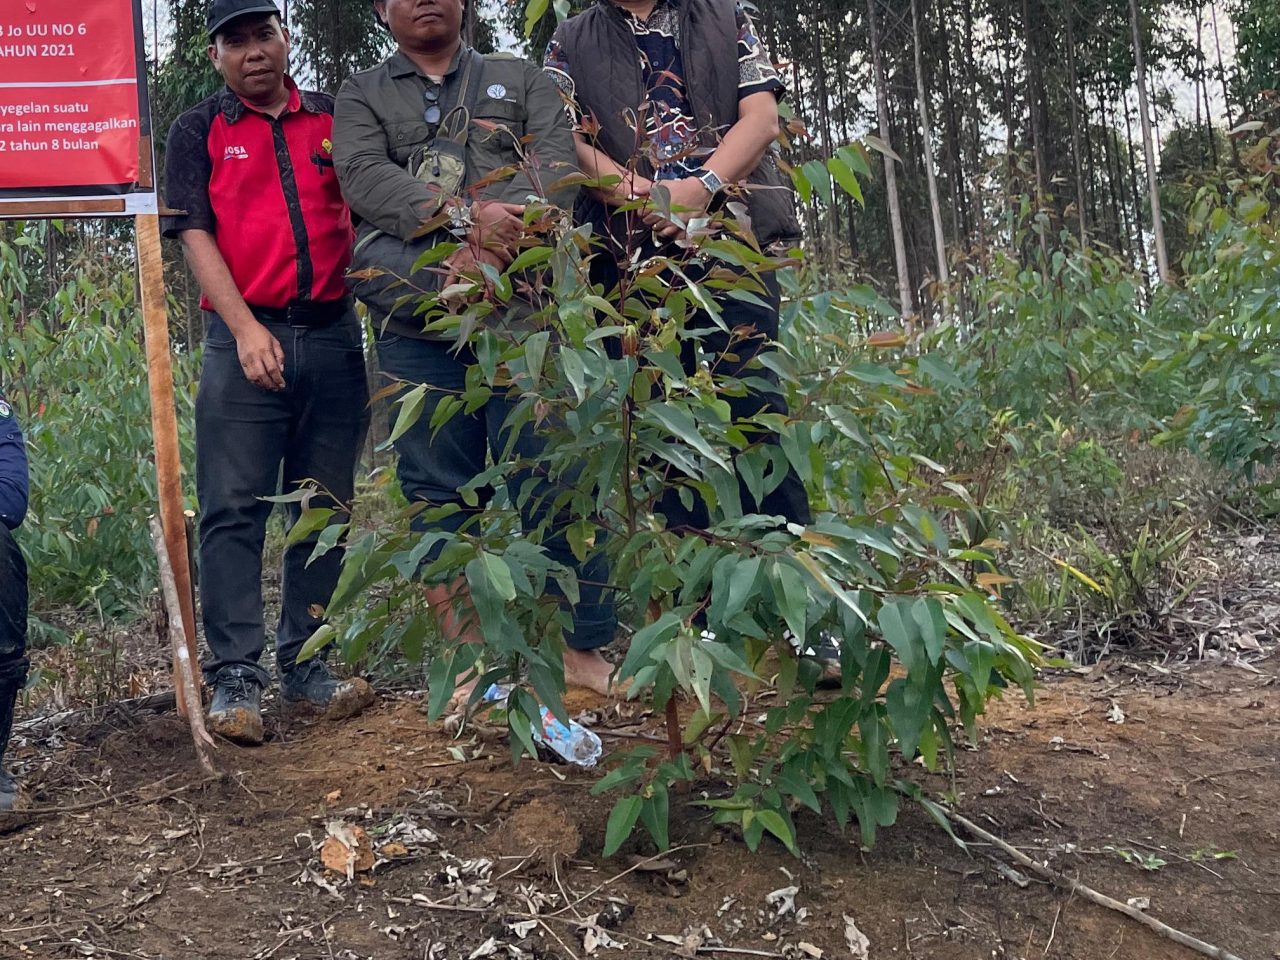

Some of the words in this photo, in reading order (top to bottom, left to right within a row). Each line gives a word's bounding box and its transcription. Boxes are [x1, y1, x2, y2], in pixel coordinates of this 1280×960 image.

[7, 24, 22, 36] Jo
[26, 24, 48, 36] UU
[51, 23, 75, 35] NO
[77, 22, 87, 35] 6
[40, 43, 75, 56] 2021
[53, 102, 89, 113] suatu
[17, 120, 42, 131] lain
[44, 117, 137, 133] menggagalkan
[9, 139, 48, 151] tahun
[51, 138, 60, 150] 8
[62, 137, 98, 150] bulan
